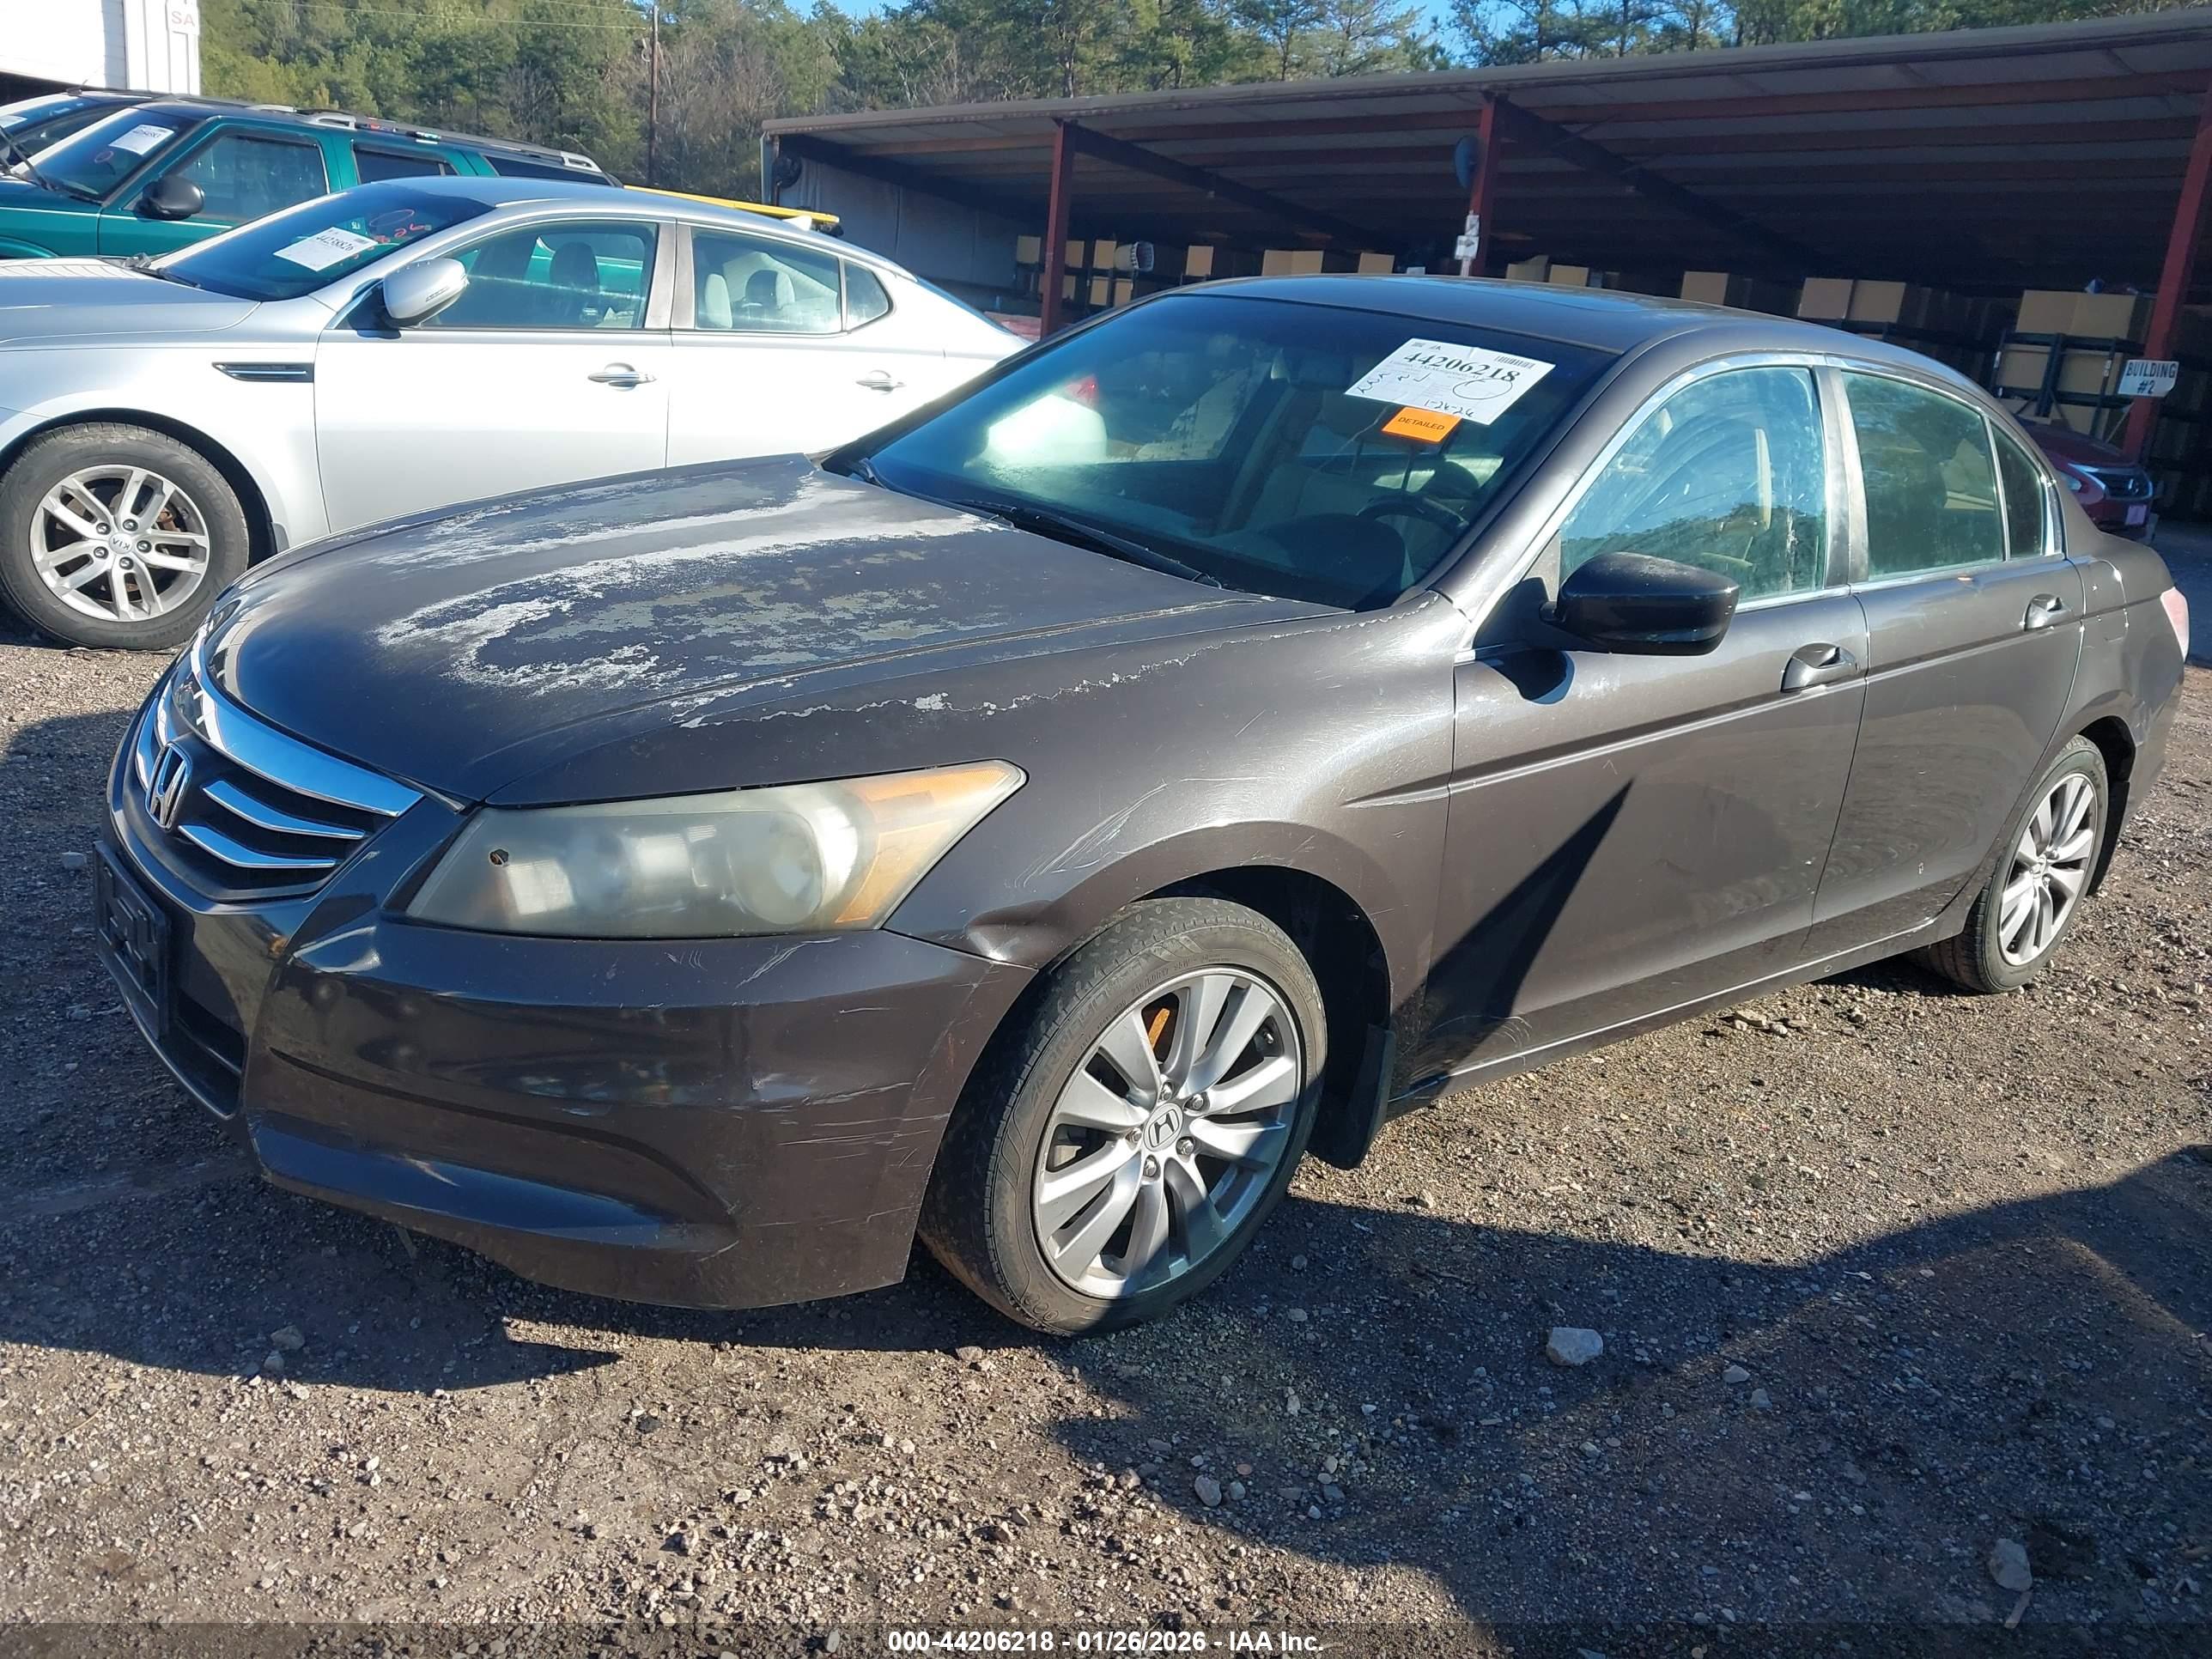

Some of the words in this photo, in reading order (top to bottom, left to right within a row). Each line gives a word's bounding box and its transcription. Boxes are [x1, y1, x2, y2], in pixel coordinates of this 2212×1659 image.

[1404, 352, 1521, 382] 44206218
[2126, 362, 2177, 378] BUILDING
[2137, 380, 2155, 394] #2
[1398, 416, 1445, 430] DETAILED
[112, 538, 131, 550] KIA
